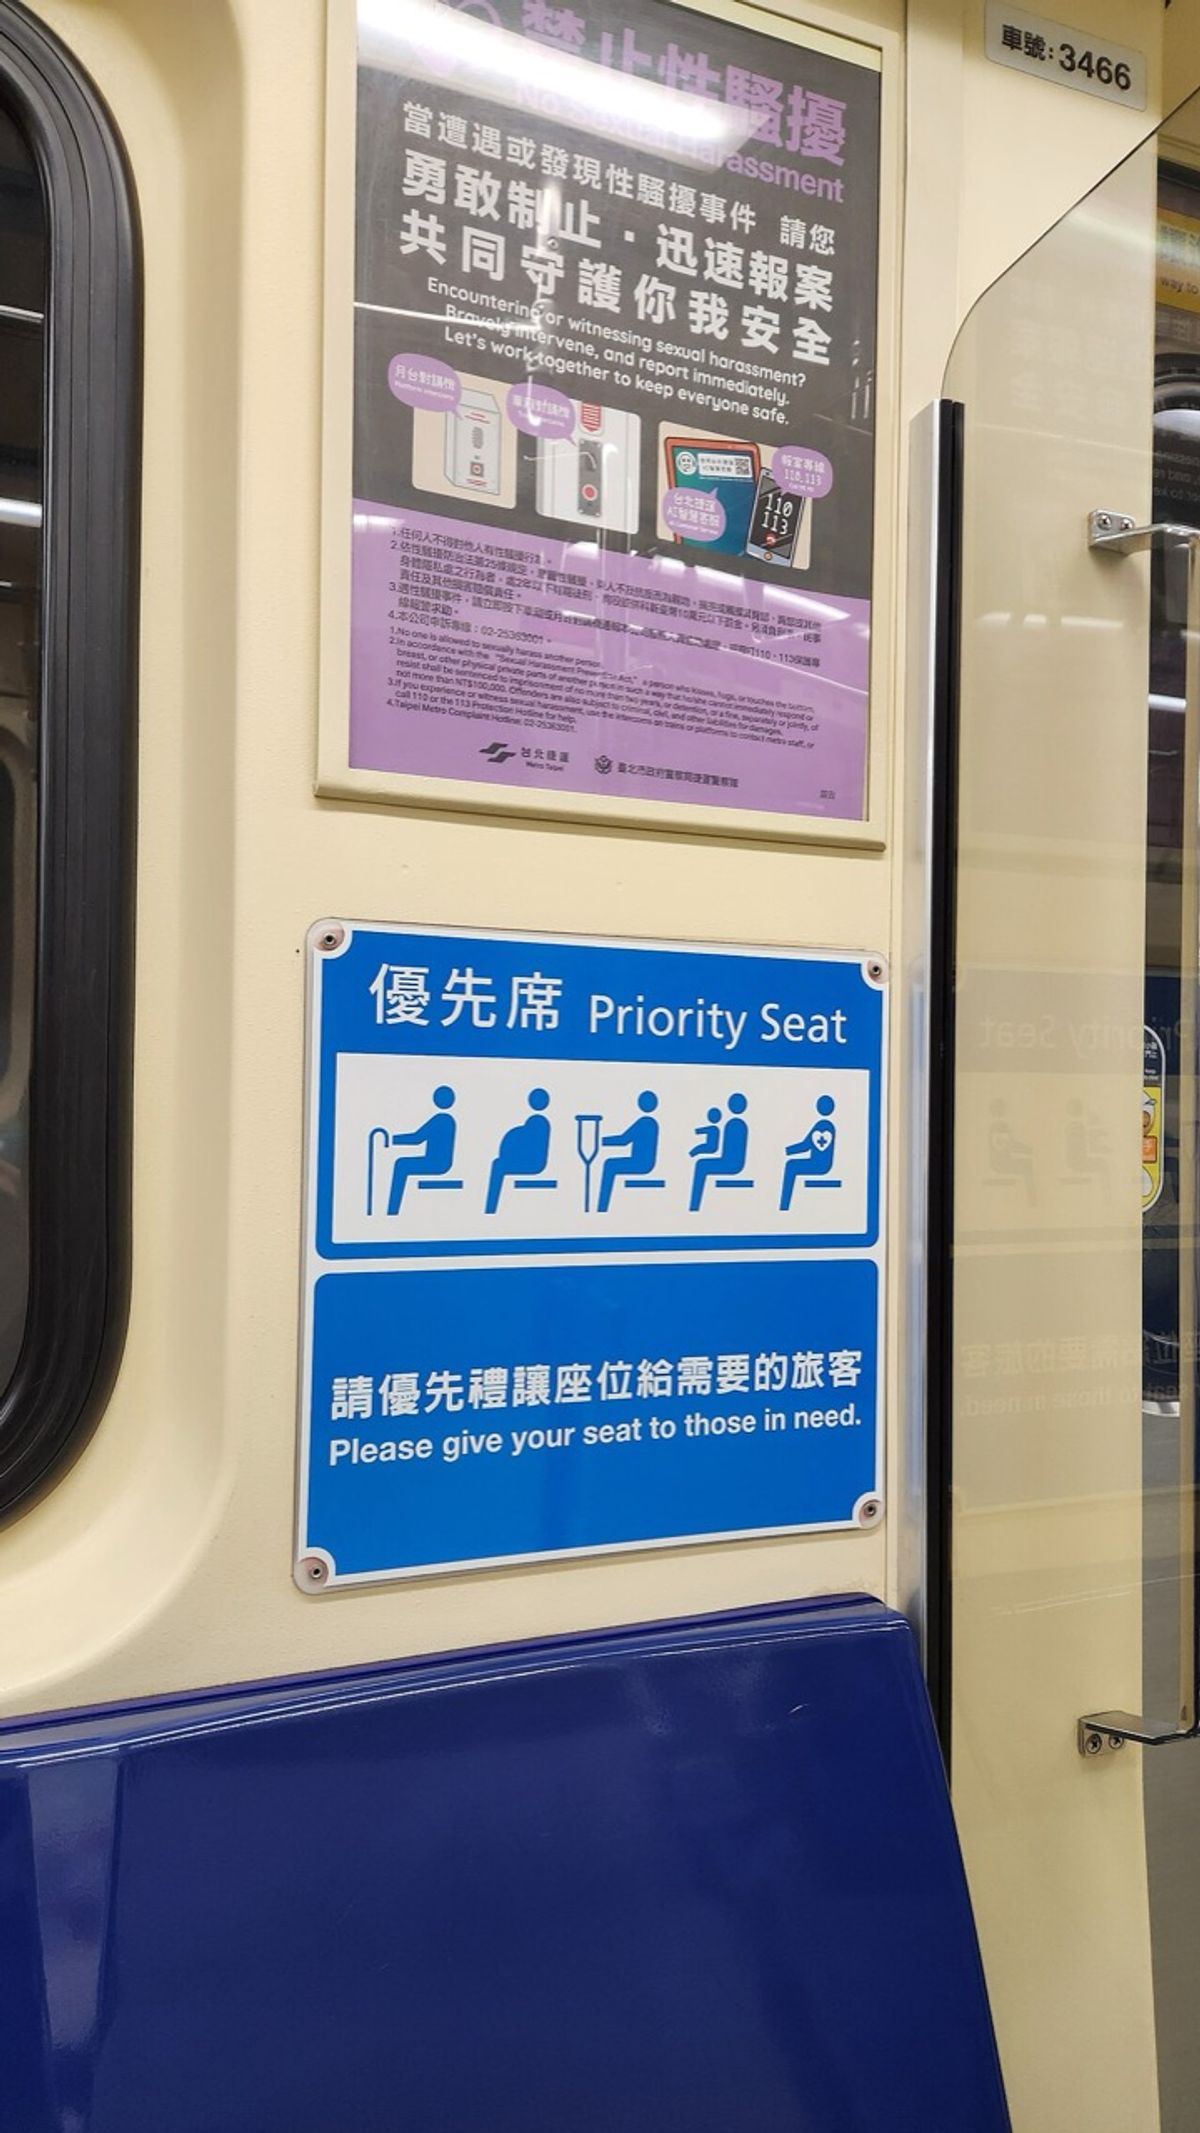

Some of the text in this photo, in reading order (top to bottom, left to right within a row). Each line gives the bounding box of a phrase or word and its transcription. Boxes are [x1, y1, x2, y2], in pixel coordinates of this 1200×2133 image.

[1058, 43, 1131, 90] 3466
[402, 100, 836, 257] 當遭遇或發現性騷擾事件 請您
[400, 208, 832, 366] 共同守護你我安全
[427, 276, 807, 388] Encountering or witnessing sexual harassment?
[514, 325, 600, 361] intervene,
[604, 347, 635, 367] and
[638, 356, 690, 381] report
[692, 368, 791, 407] immediately.
[490, 341, 535, 362] work
[536, 352, 611, 381] together
[613, 371, 632, 387] to
[635, 374, 674, 399] keep
[677, 388, 749, 416] everyone
[752, 405, 790, 426] safe.
[512, 394, 570, 418] 車對講機
[761, 511, 789, 535] 113
[764, 493, 794, 518] 110
[368, 962, 848, 1050] 優先席 Priority Seat
[330, 1349, 862, 1421] 請優先禮讓座位給需要的旅客
[328, 1403, 862, 1467] Please give your seat to those in need.
